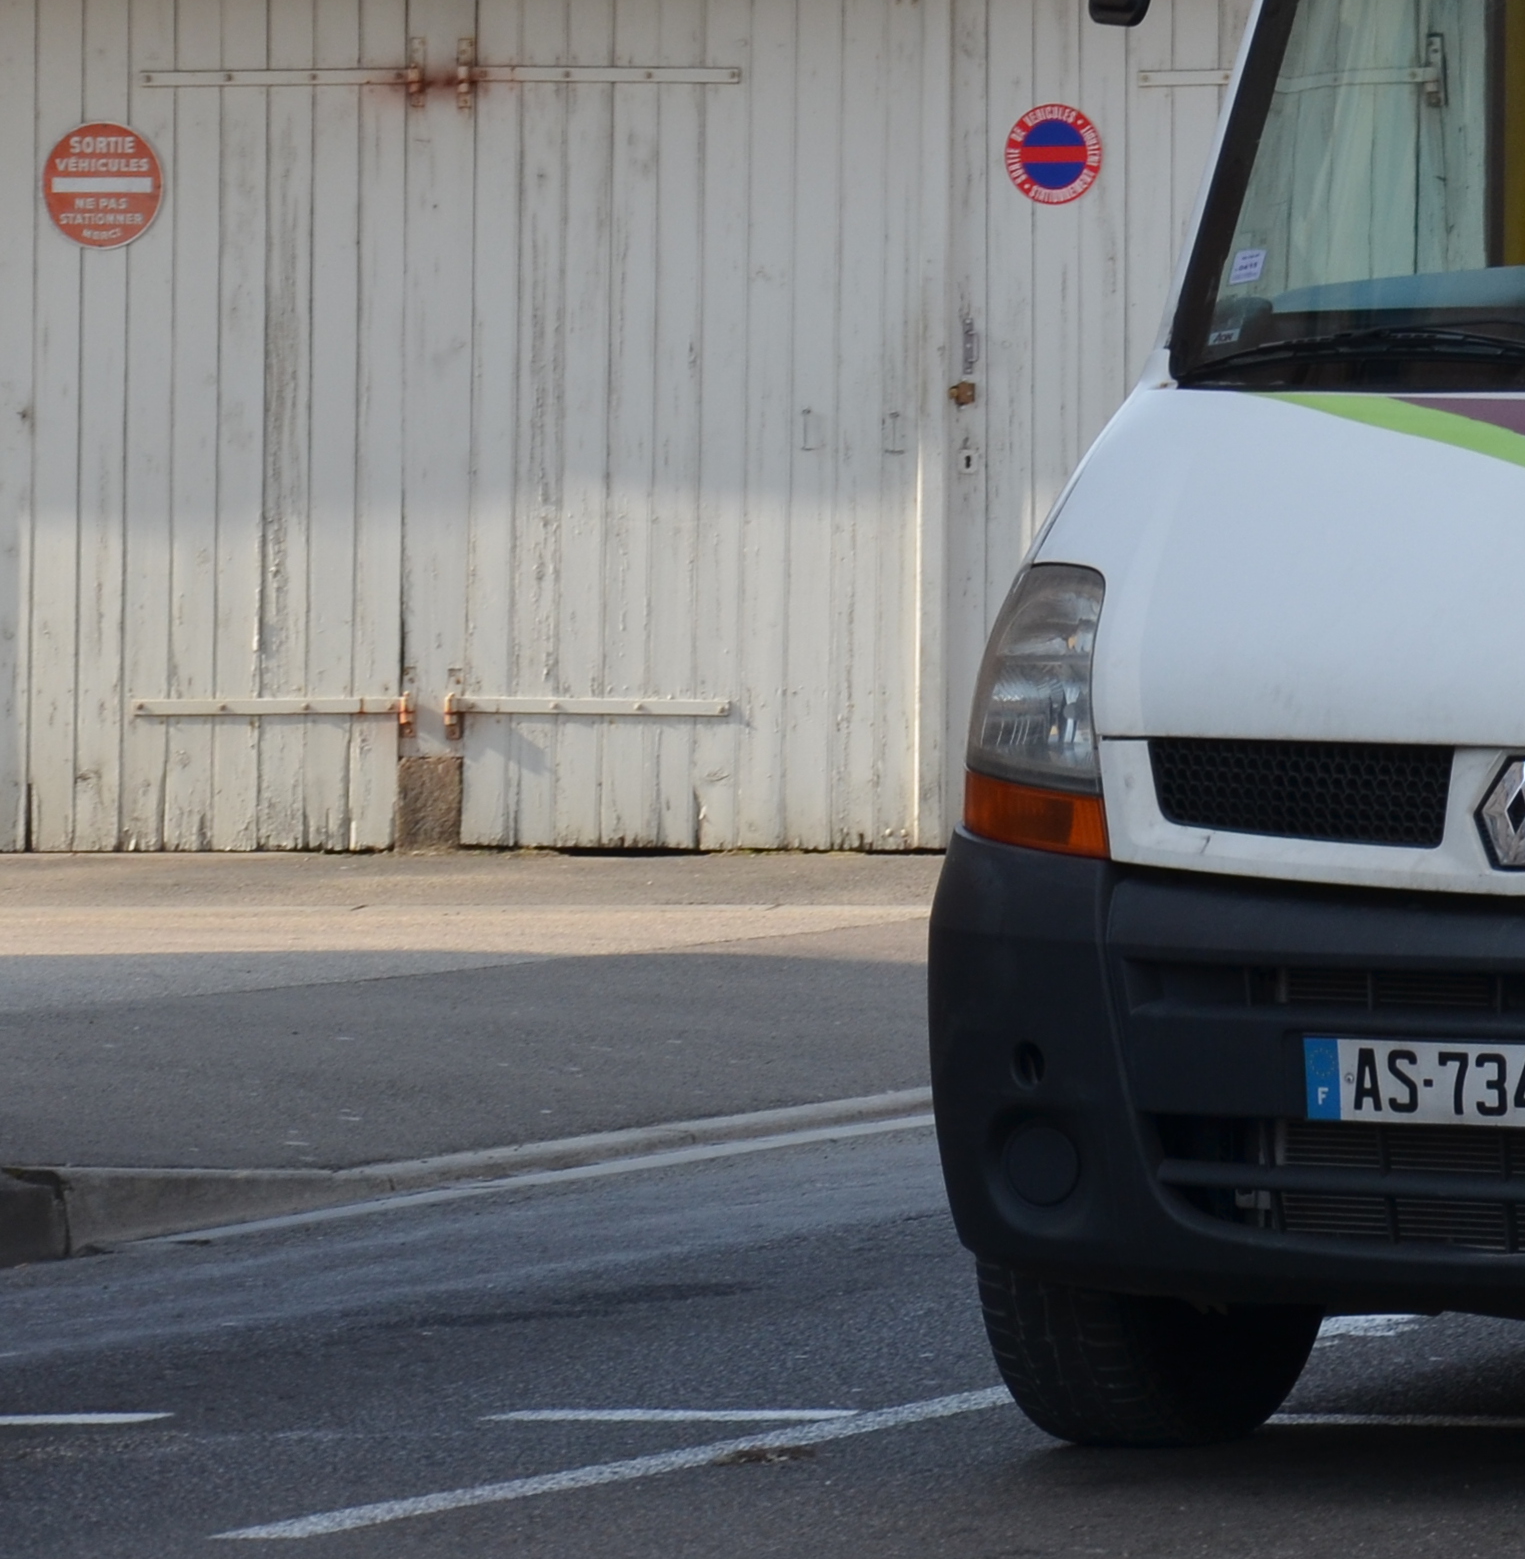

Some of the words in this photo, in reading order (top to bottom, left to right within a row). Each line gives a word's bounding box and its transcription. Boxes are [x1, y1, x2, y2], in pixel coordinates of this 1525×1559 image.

[1010, 125, 1027, 142] DE
[69, 136, 136, 154] SORTIE
[55, 155, 149, 172] VÉHICULES
[1005, 147, 1029, 185] SORTIE
[75, 198, 96, 209] NE
[98, 198, 128, 210] PAS
[59, 213, 142, 225] STATIONNER
[1317, 1087, 1329, 1105] F
